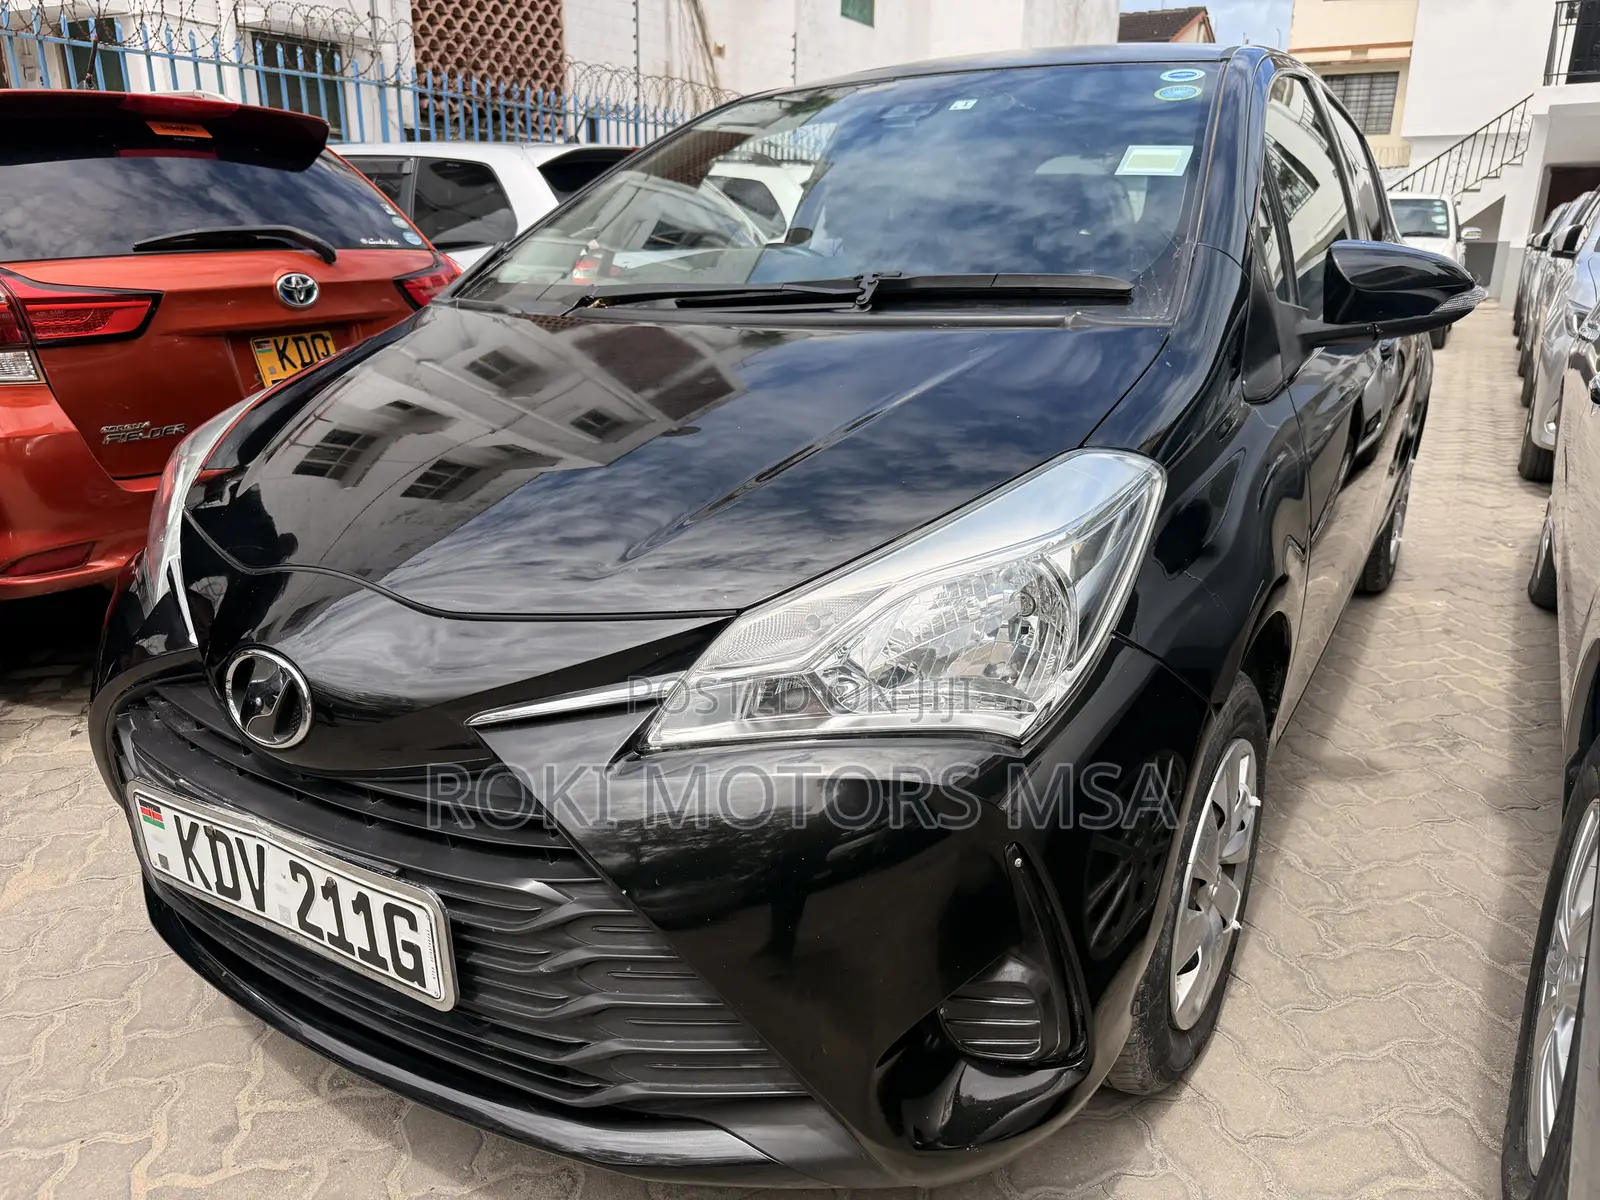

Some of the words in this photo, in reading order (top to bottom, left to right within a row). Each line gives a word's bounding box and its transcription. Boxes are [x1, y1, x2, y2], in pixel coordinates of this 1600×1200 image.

[102, 423, 187, 445] FIELDER
[173, 814, 266, 913] KDV
[289, 859, 427, 989] 211G
